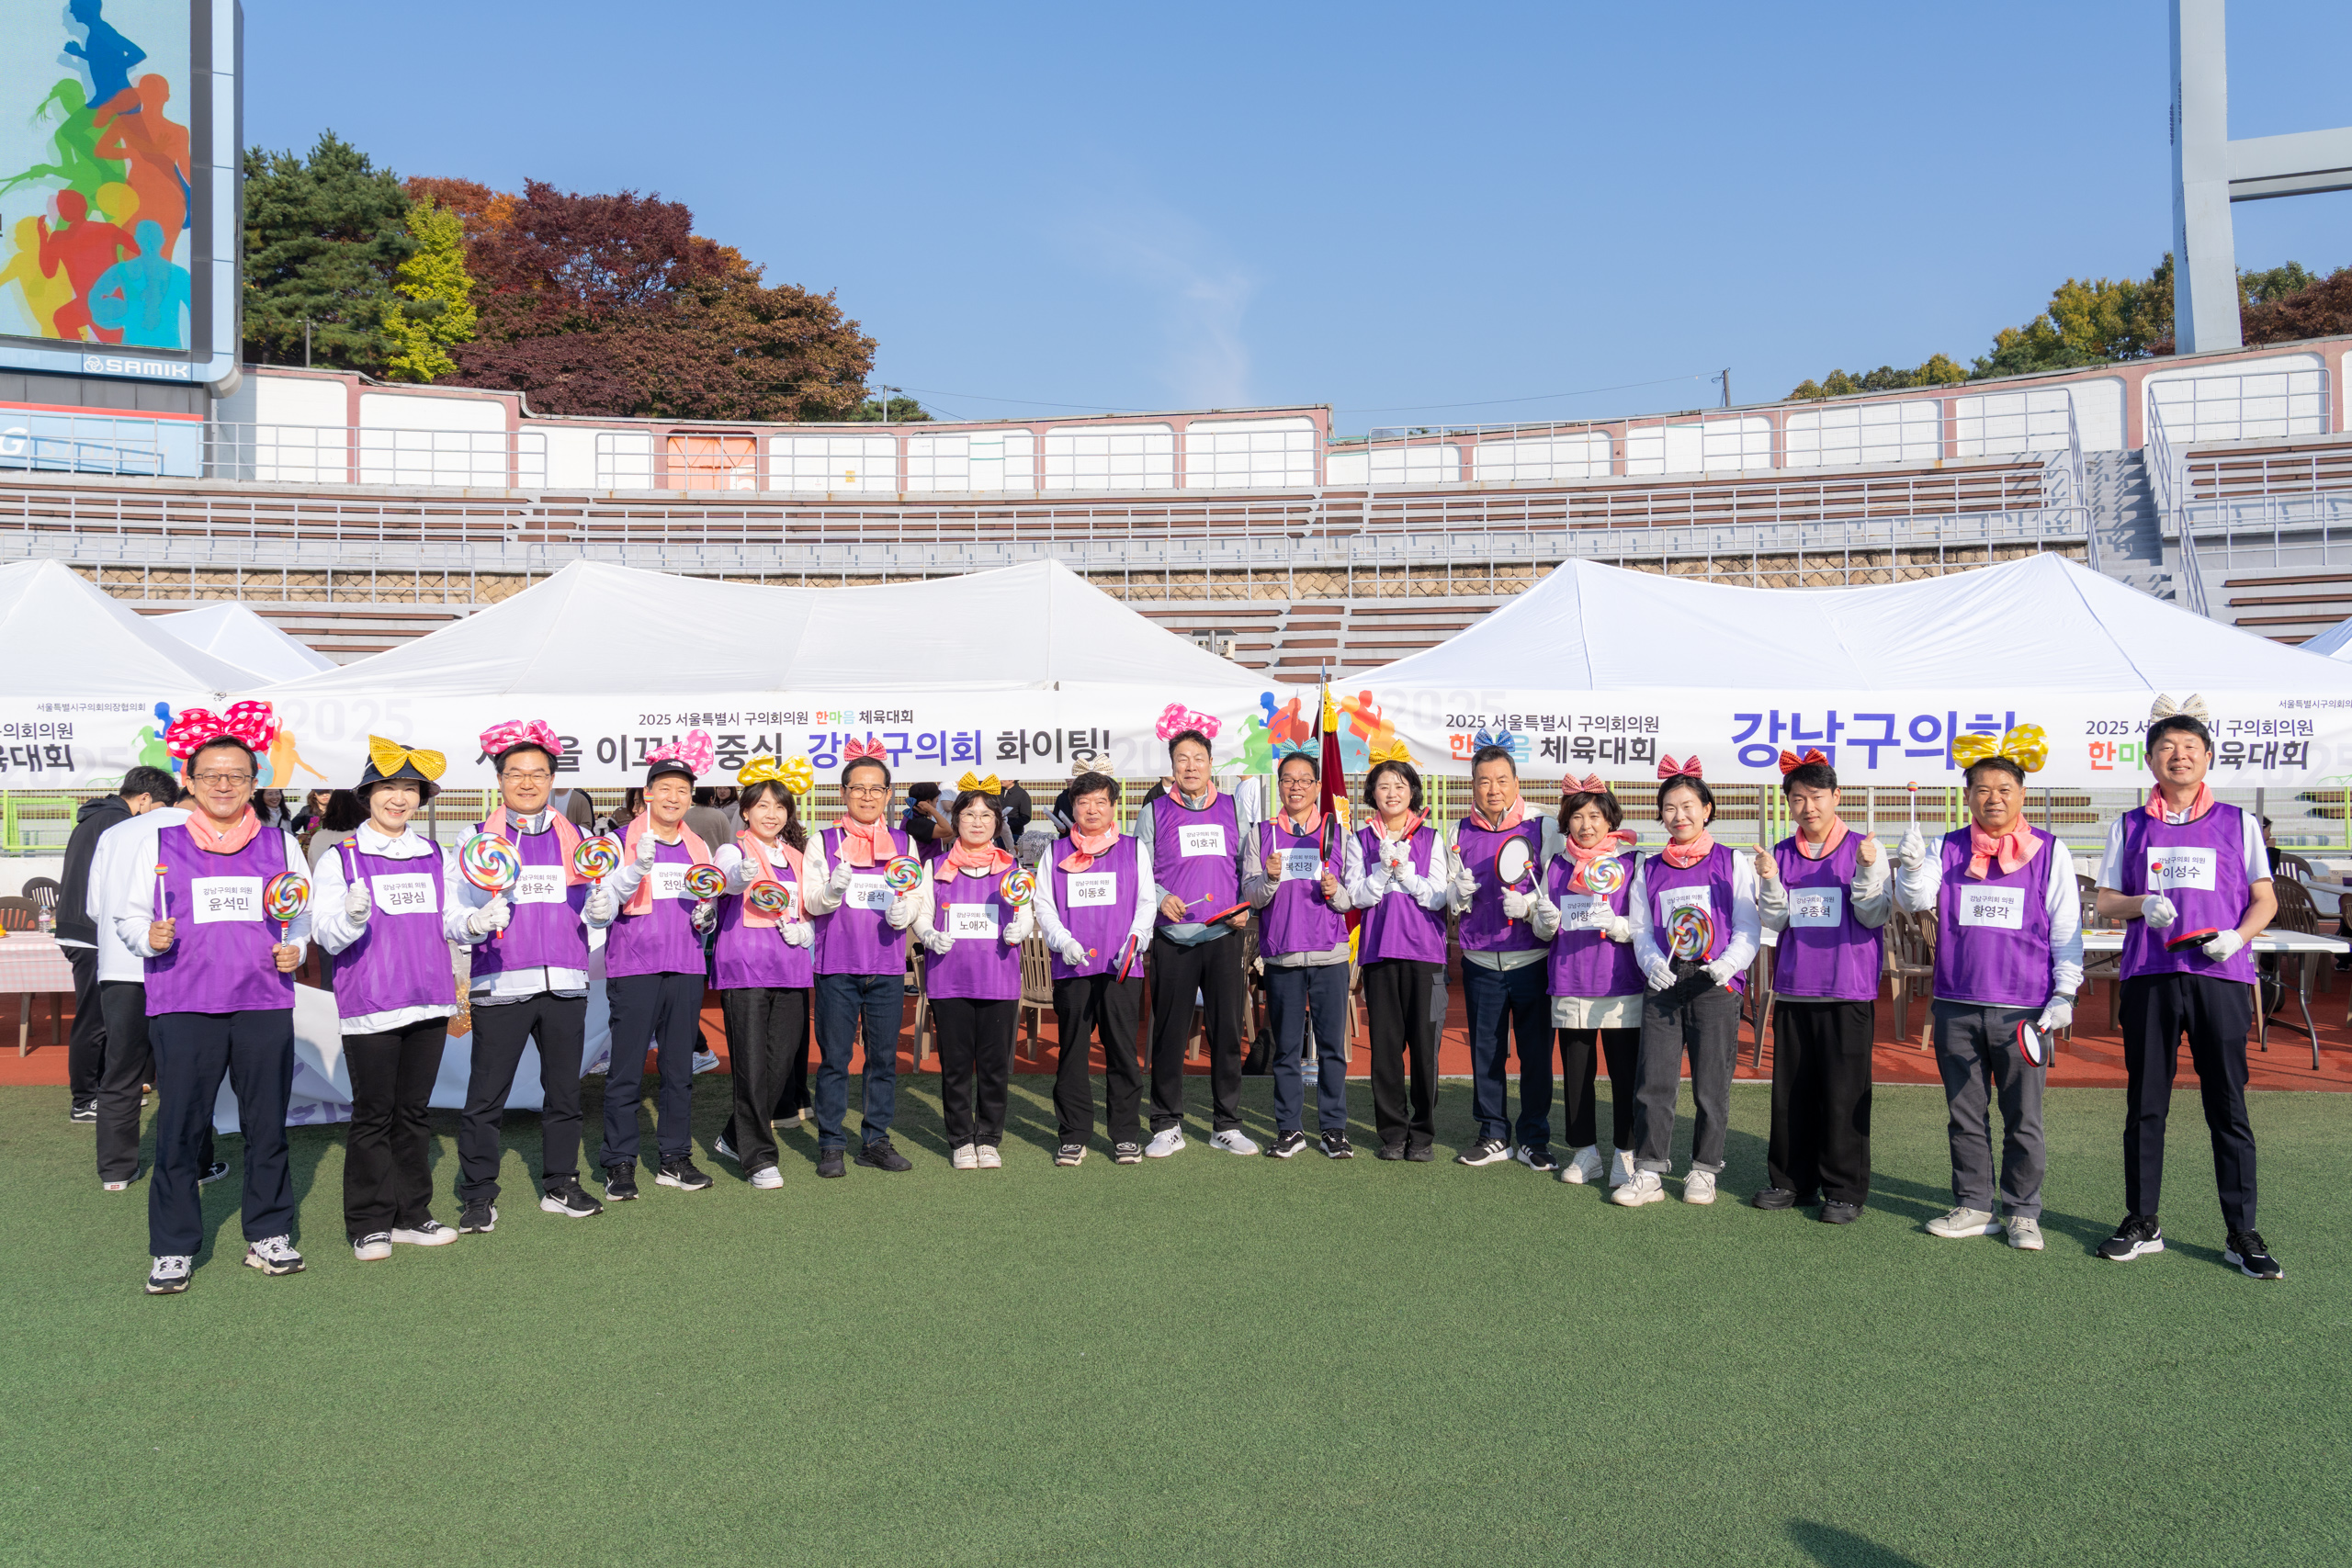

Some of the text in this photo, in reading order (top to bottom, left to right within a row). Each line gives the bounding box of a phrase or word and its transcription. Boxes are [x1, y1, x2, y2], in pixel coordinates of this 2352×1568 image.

[106, 359, 189, 378] SAMIK
[37, 703, 146, 712] 서울특별시구의회의장협의회
[639, 709, 913, 727] 2025 서울특별시 구의회의원 한마음 체육대회
[1445, 714, 1659, 733] 2025 서울특별시 구의회의원
[2086, 720, 2129, 735] 2025
[2226, 719, 2313, 737] 구의회의원
[996, 728, 1110, 764] 화이팅!
[1540, 736, 1656, 765] 체육대회
[2163, 865, 2200, 879] 이성수
[203, 886, 253, 896] 강남구의회 의원
[521, 883, 555, 895] 한윤수
[1079, 887, 1106, 898] 이동호
[209, 897, 249, 911] 윤석민
[390, 891, 425, 906] 김광심
[1800, 906, 1830, 918] 우종혁
[1973, 905, 2009, 919] 황영각
[959, 920, 988, 931] 노애자
